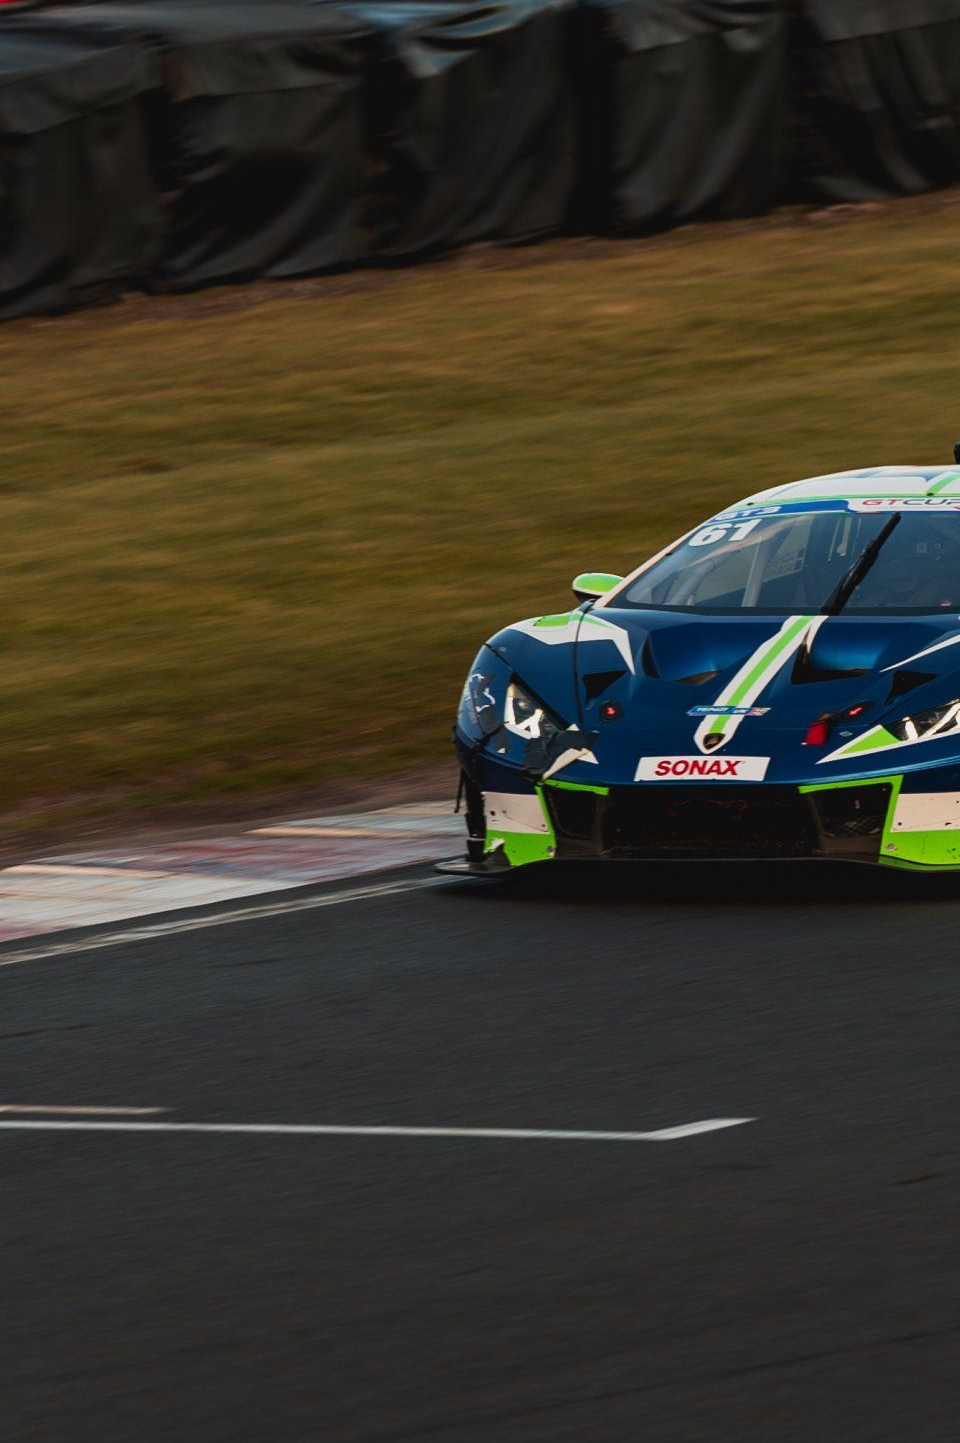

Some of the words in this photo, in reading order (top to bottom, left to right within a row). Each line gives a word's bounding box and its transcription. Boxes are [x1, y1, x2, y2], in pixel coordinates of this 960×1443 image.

[713, 506, 782, 521] GT3
[688, 518, 763, 547] 61
[654, 760, 741, 776] SONAX
